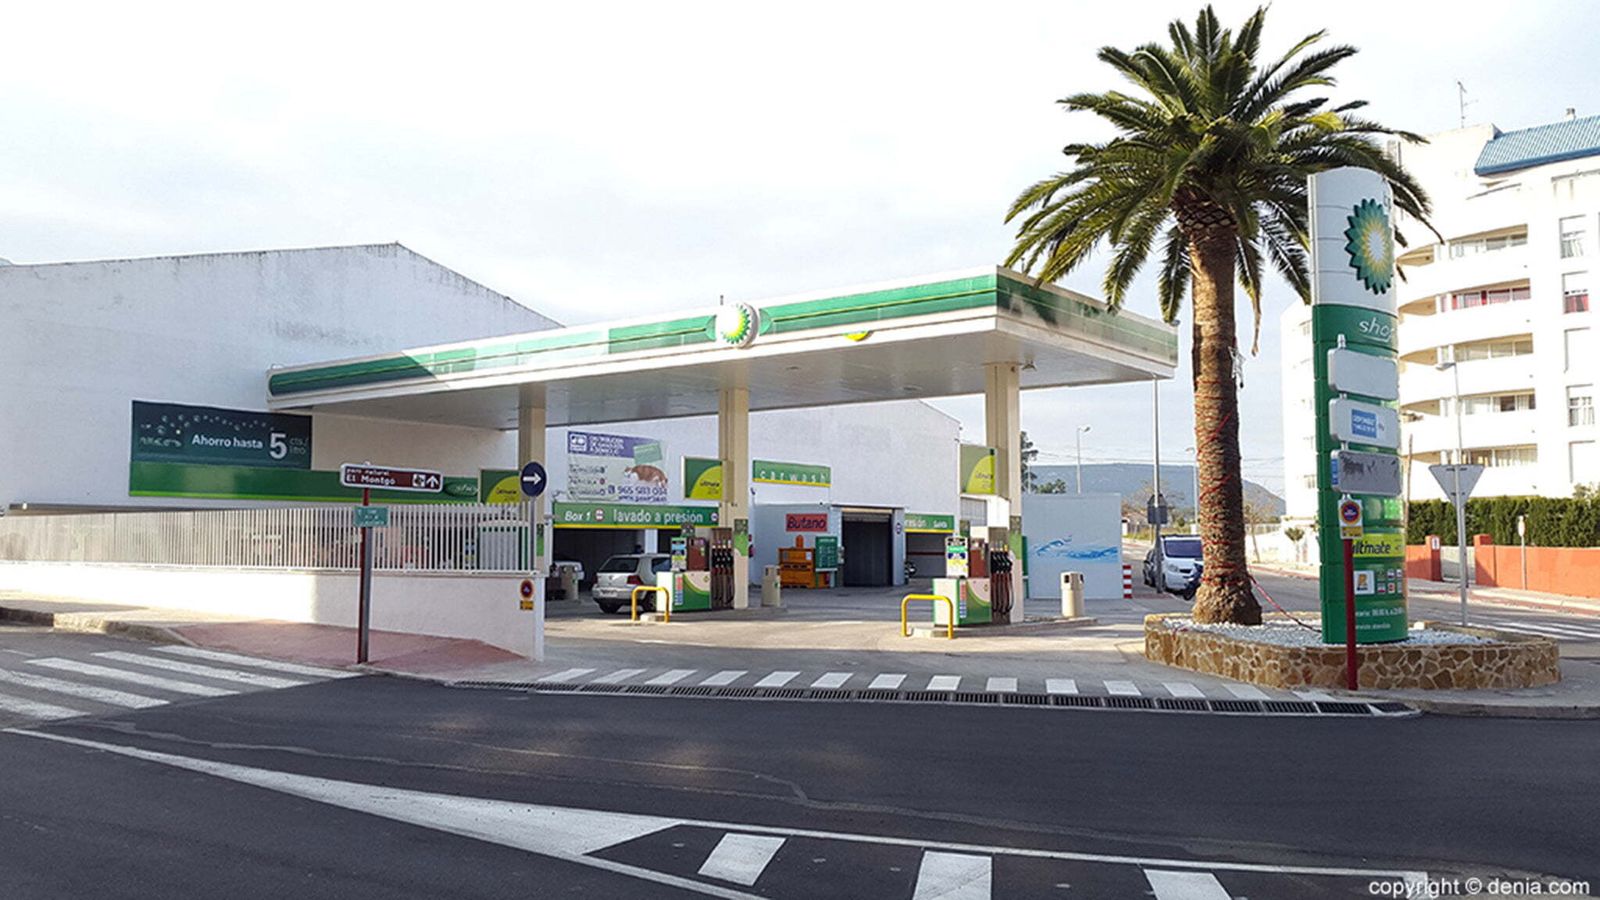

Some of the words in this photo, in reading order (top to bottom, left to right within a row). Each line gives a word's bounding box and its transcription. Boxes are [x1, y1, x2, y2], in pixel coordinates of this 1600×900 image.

[191, 434, 232, 447] Ahorro
[233, 438, 263, 449] hasta
[269, 432, 287, 460] 5
[346, 473, 356, 482] El
[759, 470, 785, 481] car
[789, 472, 829, 484] wash
[564, 510, 583, 521] Box
[586, 511, 591, 521] 1
[613, 509, 652, 522] lavado
[655, 513, 661, 522] a
[786, 513, 827, 530] Butano
